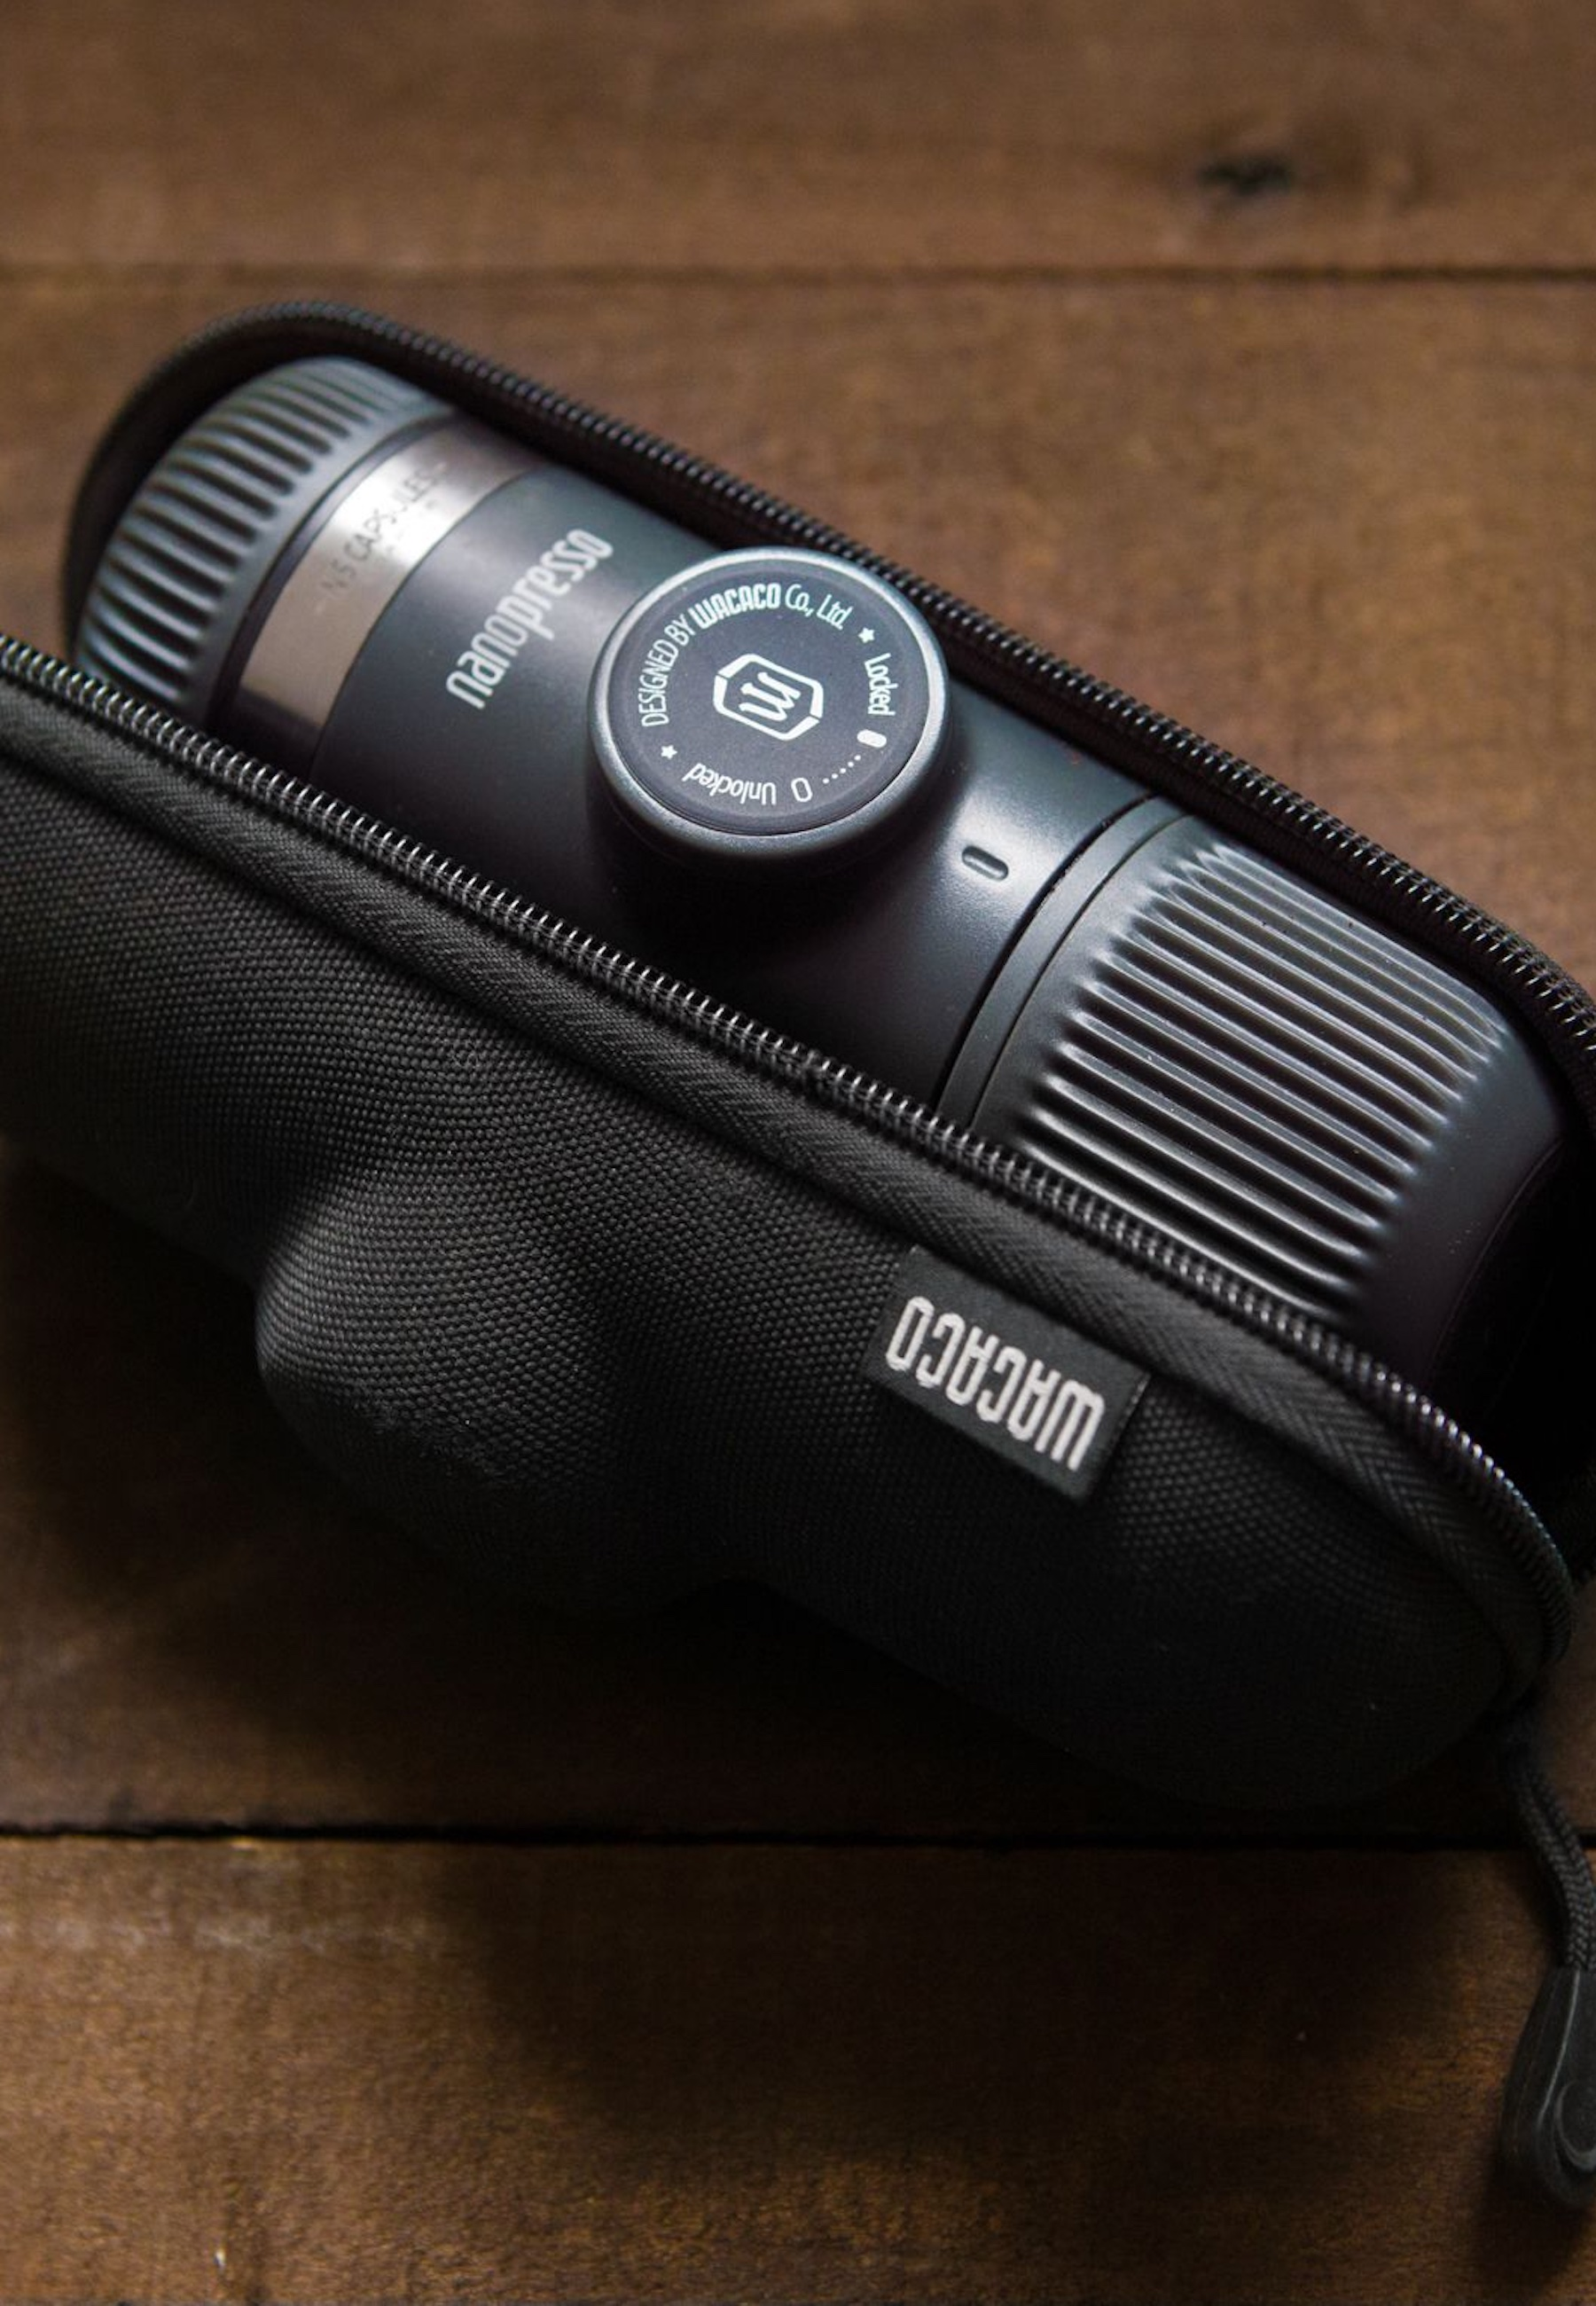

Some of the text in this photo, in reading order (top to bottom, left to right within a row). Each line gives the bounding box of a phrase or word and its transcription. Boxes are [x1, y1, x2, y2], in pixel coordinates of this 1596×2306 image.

[446, 529, 614, 709] nanopresso
[639, 639, 679, 727] DESIGNED
[664, 613, 699, 647] BY
[689, 583, 781, 630] WACACO
[817, 594, 855, 631] Ltd.
[864, 653, 898, 716] Locked
[682, 763, 777, 805] Unlocked
[886, 1296, 1105, 1471] WACACO
